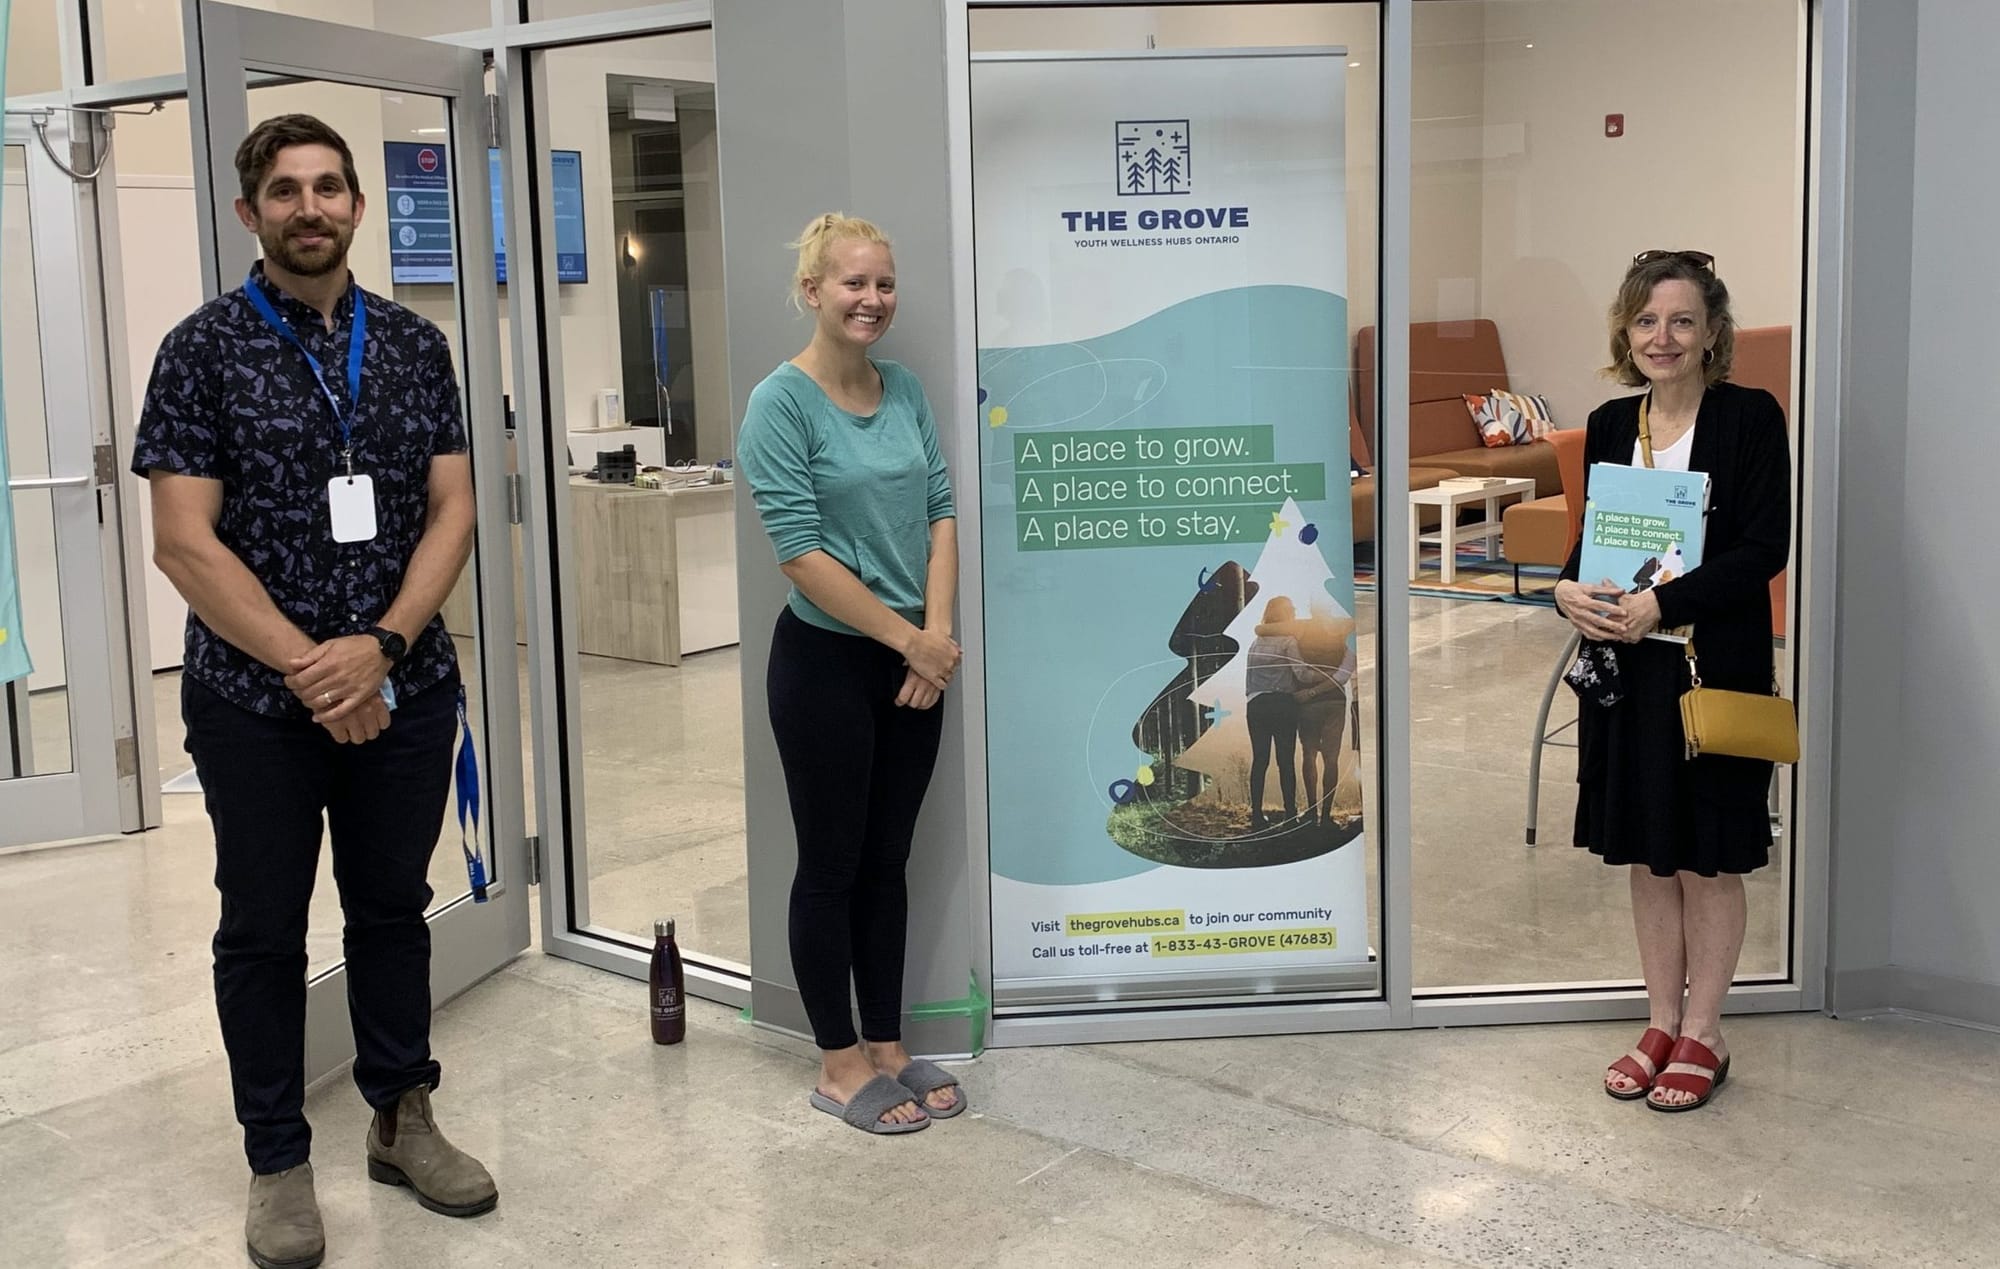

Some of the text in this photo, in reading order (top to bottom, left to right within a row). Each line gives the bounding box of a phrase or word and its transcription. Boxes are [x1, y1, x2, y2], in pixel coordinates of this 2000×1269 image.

[1061, 207, 1249, 232] THE GROVE
[1074, 235, 1240, 248] YOUTH WELLNESS HUBS ONTARIO
[1020, 434, 1250, 468] A place to grow.
[1022, 468, 1299, 507] A place to connect.
[1023, 511, 1241, 547] A place to stay.
[1596, 524, 1681, 540] A place to connect.
[1597, 513, 1667, 528] A place to grow.
[1595, 536, 1663, 551] A place to stay.
[1031, 907, 1333, 933] Visit thegrovehubs.ca to join our community
[1032, 930, 1333, 959] Call us toll-free at 1-833-43-GROVE (47683)
